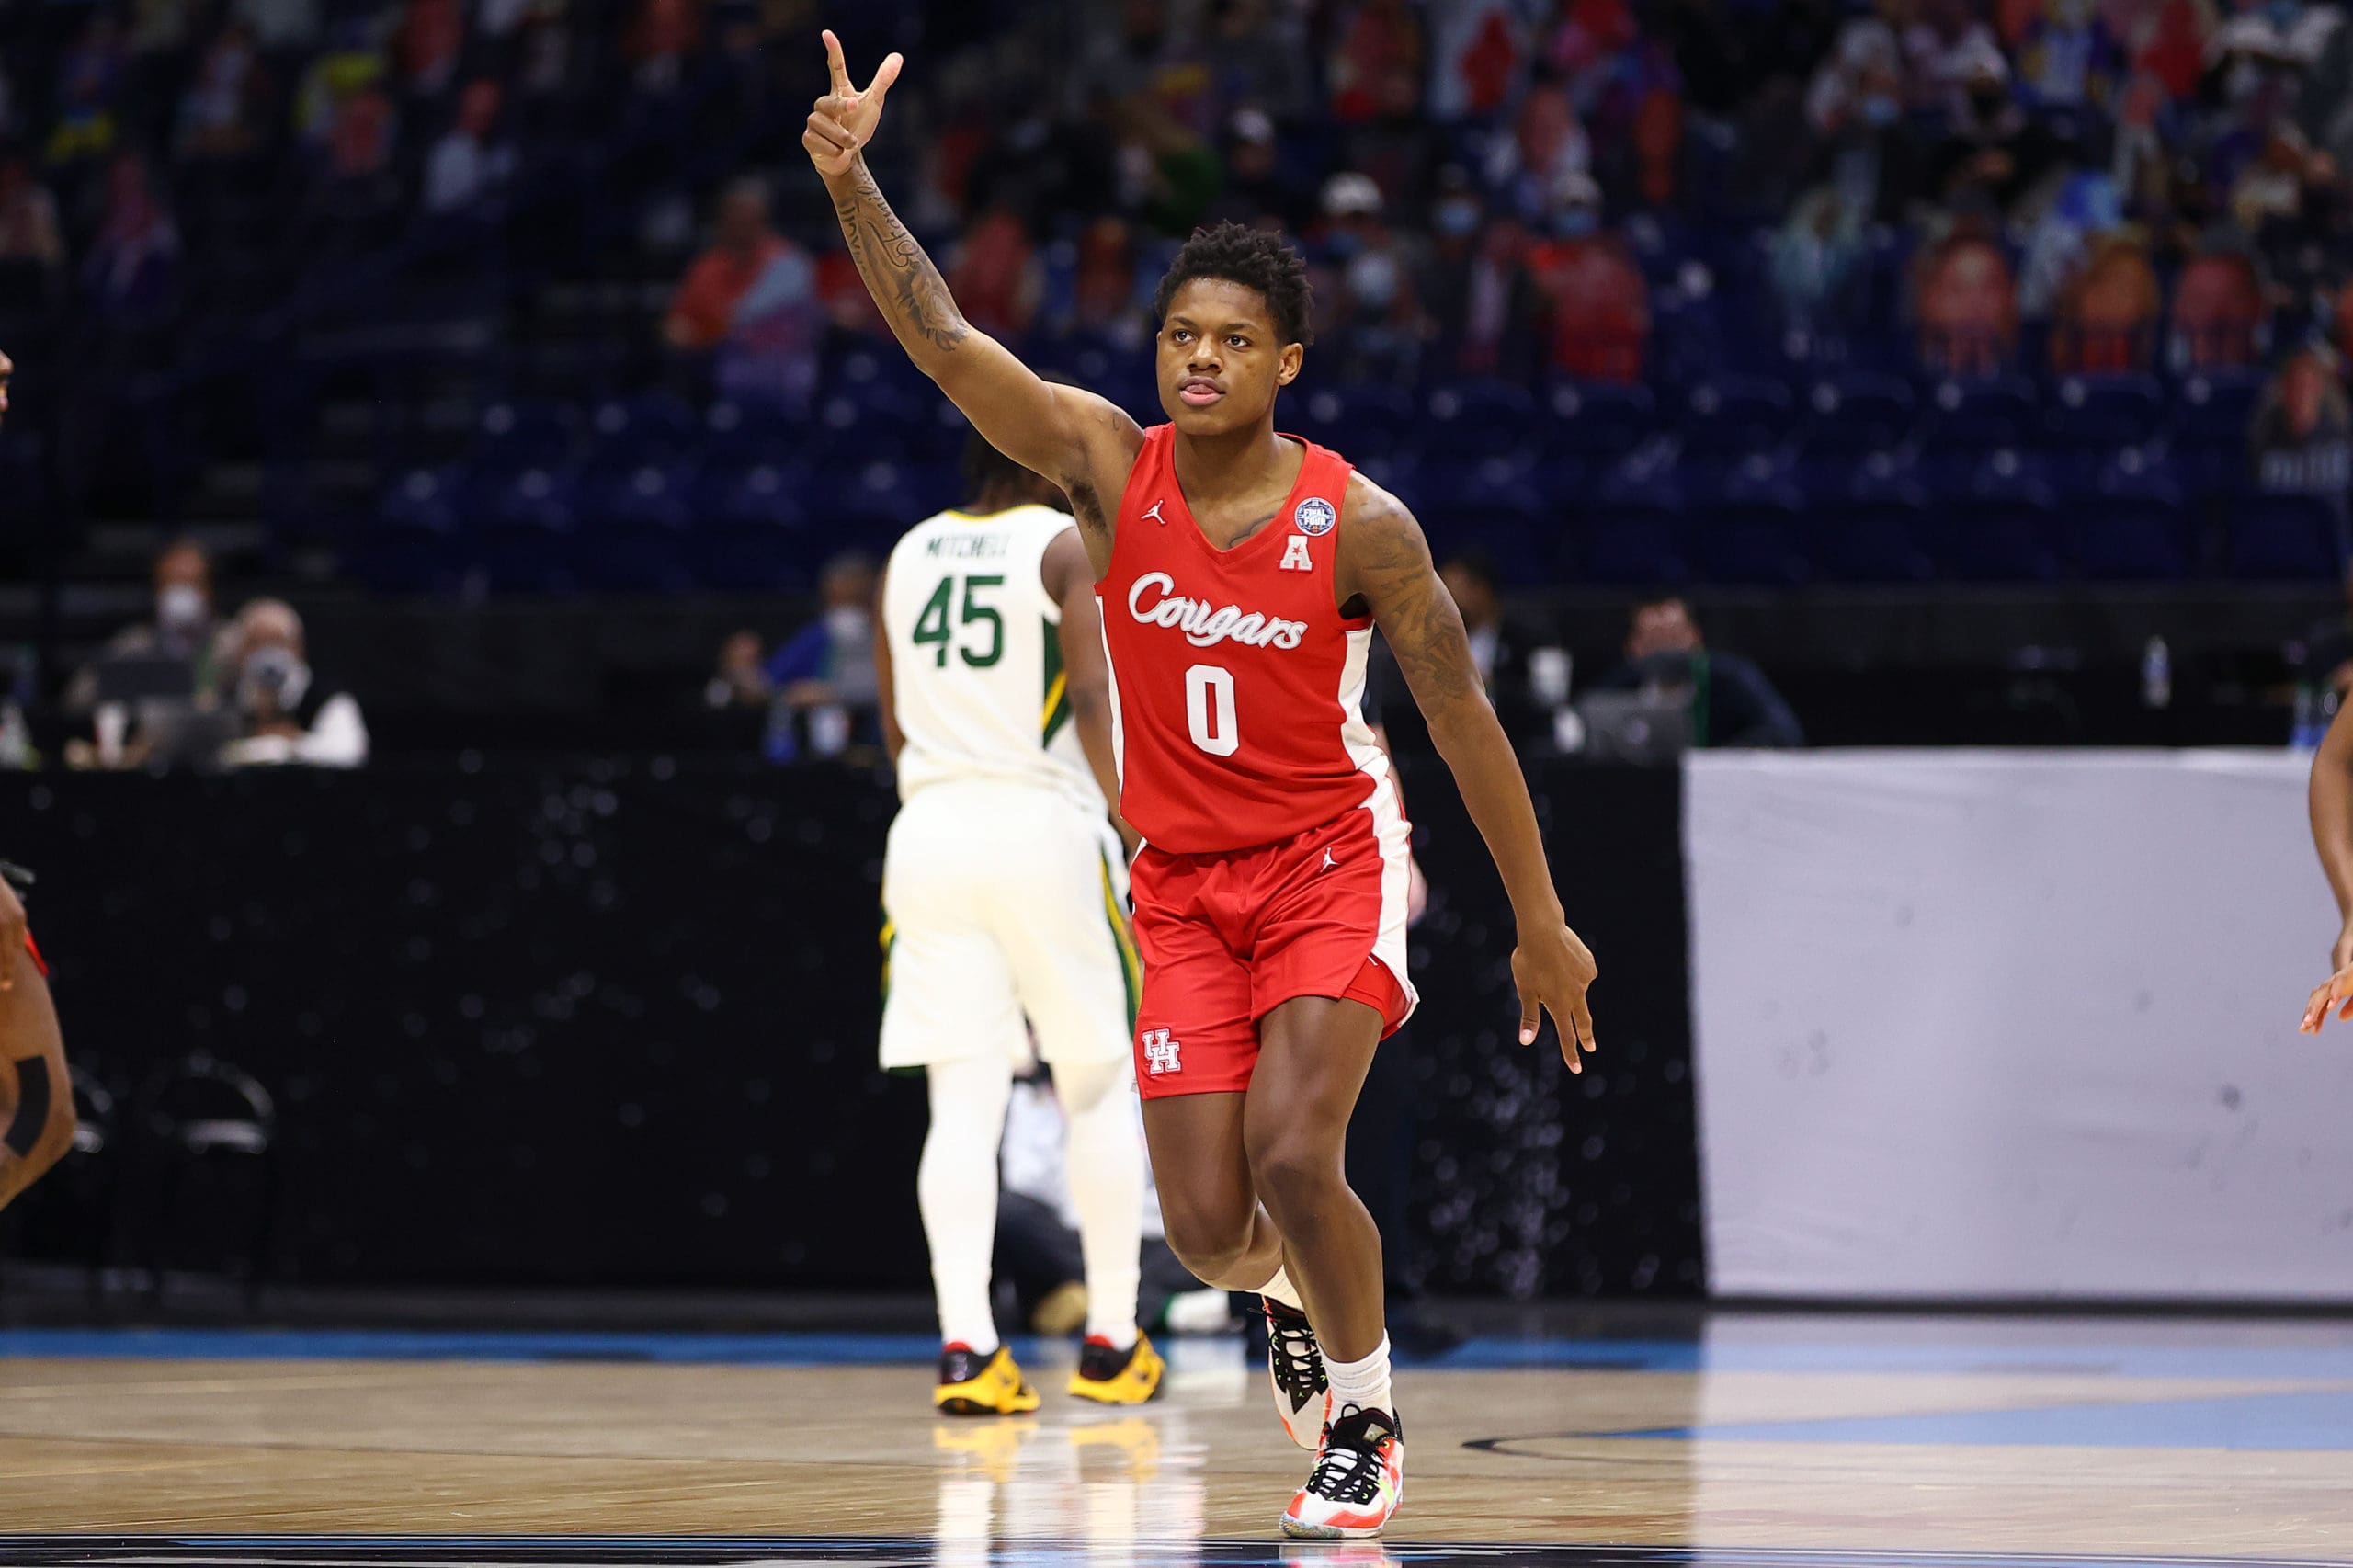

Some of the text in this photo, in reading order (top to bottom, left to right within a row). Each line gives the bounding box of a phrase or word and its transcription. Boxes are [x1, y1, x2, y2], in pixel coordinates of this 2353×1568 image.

[1303, 507, 1325, 517] FINAL
[1303, 517, 1326, 526] FOUR
[1279, 535, 1313, 571] A
[913, 575, 1004, 668] 45
[1128, 572, 1309, 650] Cougars
[1185, 664, 1239, 757] 0
[1142, 1028, 1181, 1074] UH
